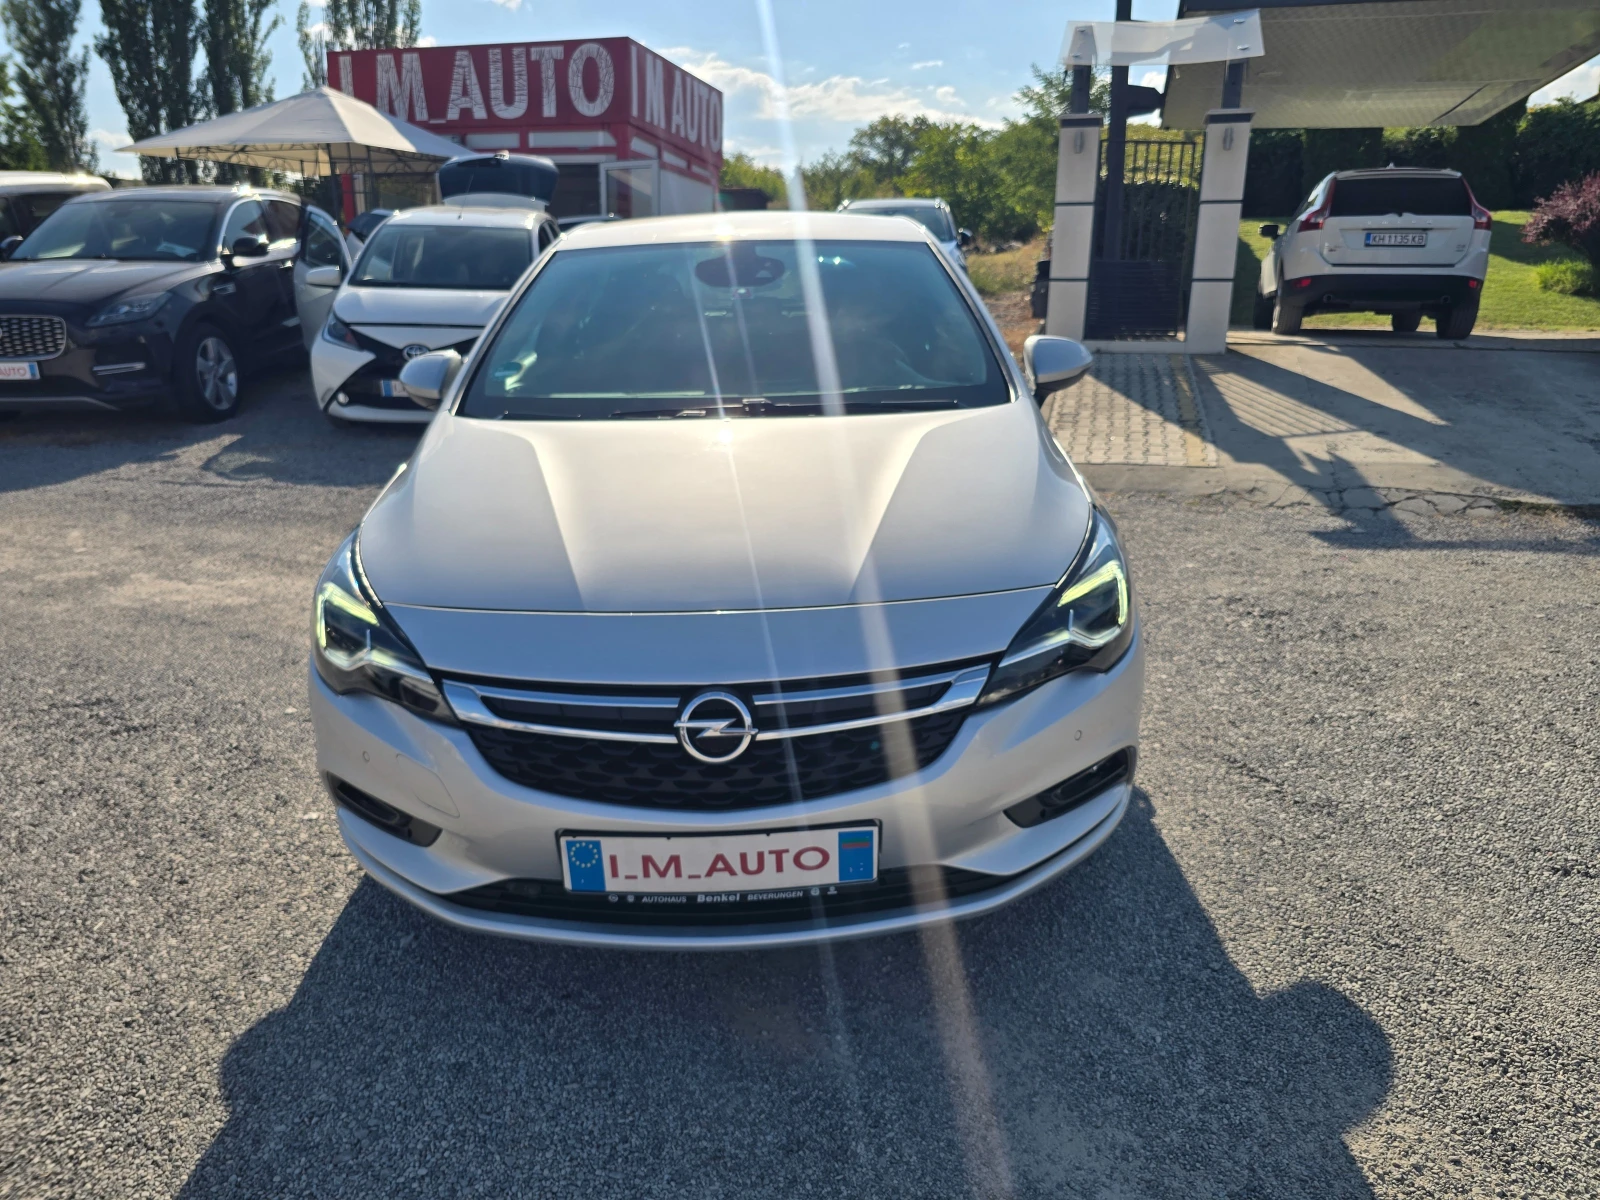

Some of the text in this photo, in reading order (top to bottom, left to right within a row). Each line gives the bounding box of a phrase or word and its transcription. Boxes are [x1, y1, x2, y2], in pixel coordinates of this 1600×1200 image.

[631, 45, 722, 153] I M AUTO
[609, 846, 830, 879] I_M_AUTO
[641, 890, 804, 904] AUTOHAUS Benkel BEVERUNGEN
